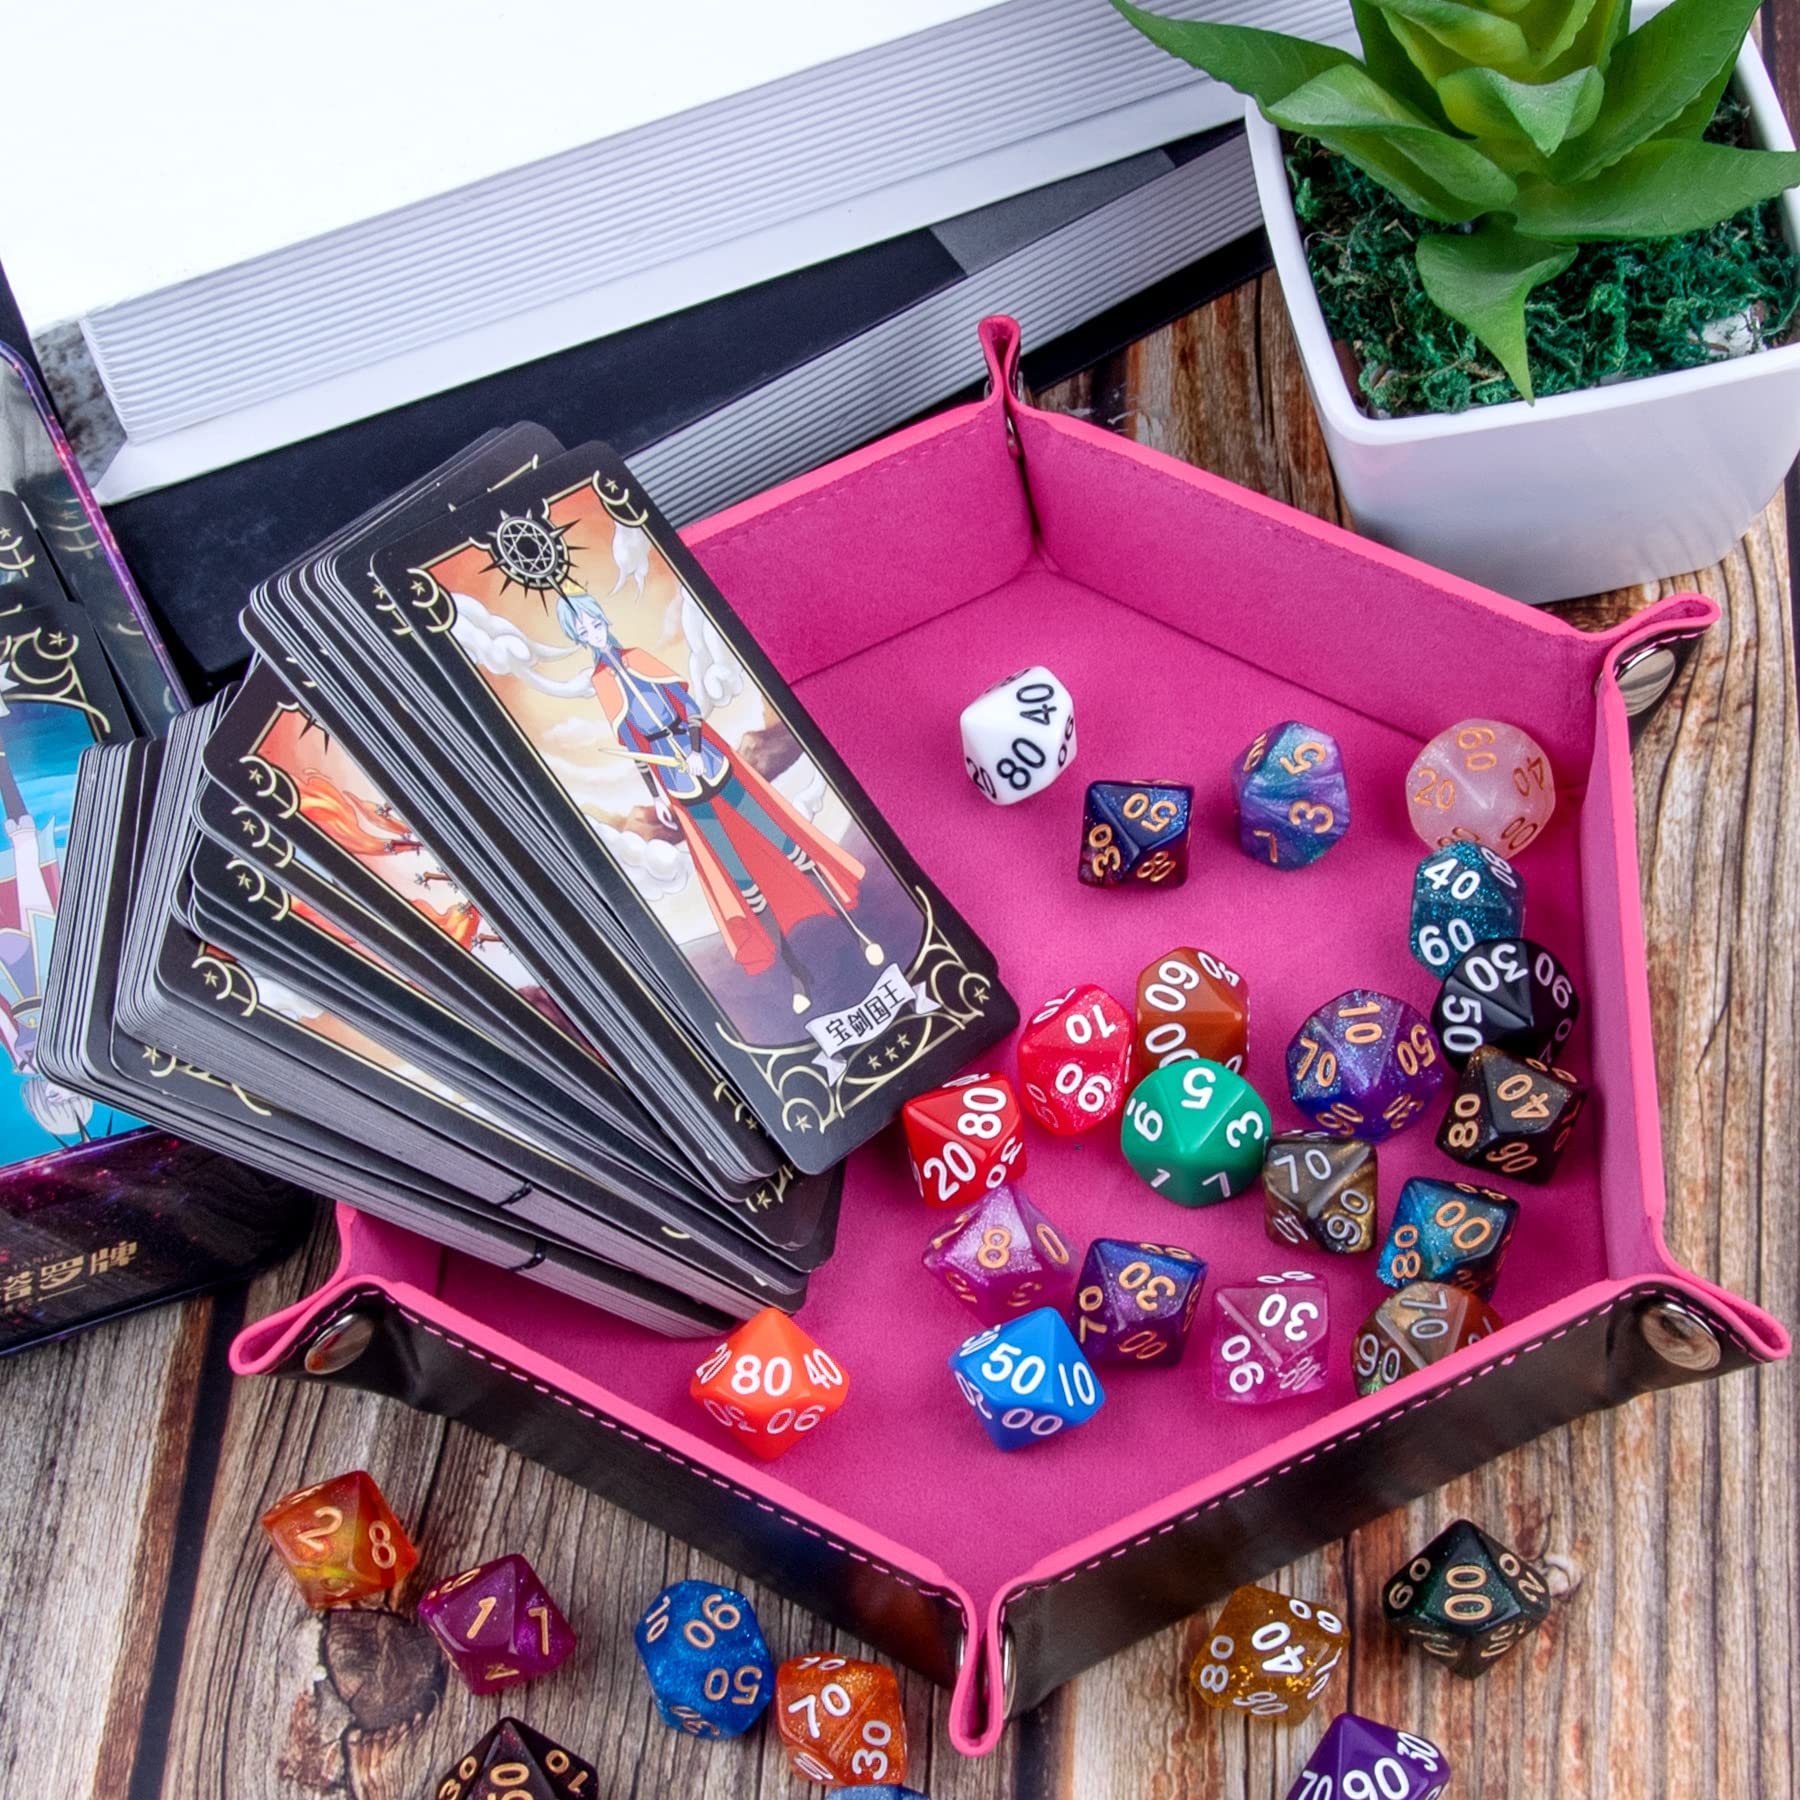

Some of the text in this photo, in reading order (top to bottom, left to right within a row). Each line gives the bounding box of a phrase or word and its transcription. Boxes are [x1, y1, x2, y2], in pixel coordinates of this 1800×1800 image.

[1016, 683, 1058, 726] 40
[966, 756, 997, 800] 20
[997, 737, 1046, 791] 80
[1280, 741, 1327, 775] 5
[1512, 757, 1545, 798] 40
[1123, 792, 1178, 832] 50
[1414, 767, 1456, 811] 20
[1288, 799, 1334, 834] 3
[1088, 823, 1121, 878] 30
[1423, 858, 1481, 900] 40
[1418, 918, 1475, 966] 60
[1197, 951, 1240, 987] 40
[1465, 943, 1529, 992] 30
[825, 979, 906, 1047] 宝剑国王
[1065, 1004, 1116, 1044] 10
[1338, 1001, 1383, 1044] 10
[1442, 994, 1483, 1053] 50
[1296, 1037, 1337, 1088] 70
[1397, 1023, 1436, 1077] 50
[1180, 1067, 1217, 1109] 5
[1497, 1073, 1550, 1119] 40
[957, 1087, 1007, 1140] 80
[1225, 1110, 1263, 1148] 3
[1448, 1093, 1481, 1148] 80
[923, 1141, 977, 1202] 20
[1202, 1171, 1231, 1199] 7
[1273, 1149, 1332, 1194] 70
[977, 1225, 1013, 1269] 8
[1036, 1223, 1070, 1265] 0
[1435, 1200, 1492, 1249] 00
[1391, 1224, 1421, 1279] 80
[1119, 1261, 1176, 1311] 30
[1079, 1285, 1108, 1344] 70
[1258, 1293, 1319, 1341] 30
[1400, 1290, 1449, 1339] 70
[731, 1354, 793, 1396] 80
[803, 1348, 843, 1390] 40
[981, 1342, 1046, 1395] 50
[1357, 1333, 1400, 1384] 90
[1058, 1361, 1096, 1407] 10
[1001, 1408, 1063, 1436] 00
[295, 1506, 343, 1551] 2
[368, 1520, 397, 1569] 8
[1388, 1556, 1431, 1610] 60
[1444, 1564, 1493, 1621] 00
[466, 1596, 497, 1640] 1
[527, 1606, 549, 1656] 7
[645, 1595, 671, 1643] 10
[1200, 1635, 1235, 1693] 80
[1251, 1620, 1305, 1674] 40
[704, 1665, 763, 1705] 50
[787, 1682, 852, 1739] 70
[852, 1720, 892, 1781] 30
